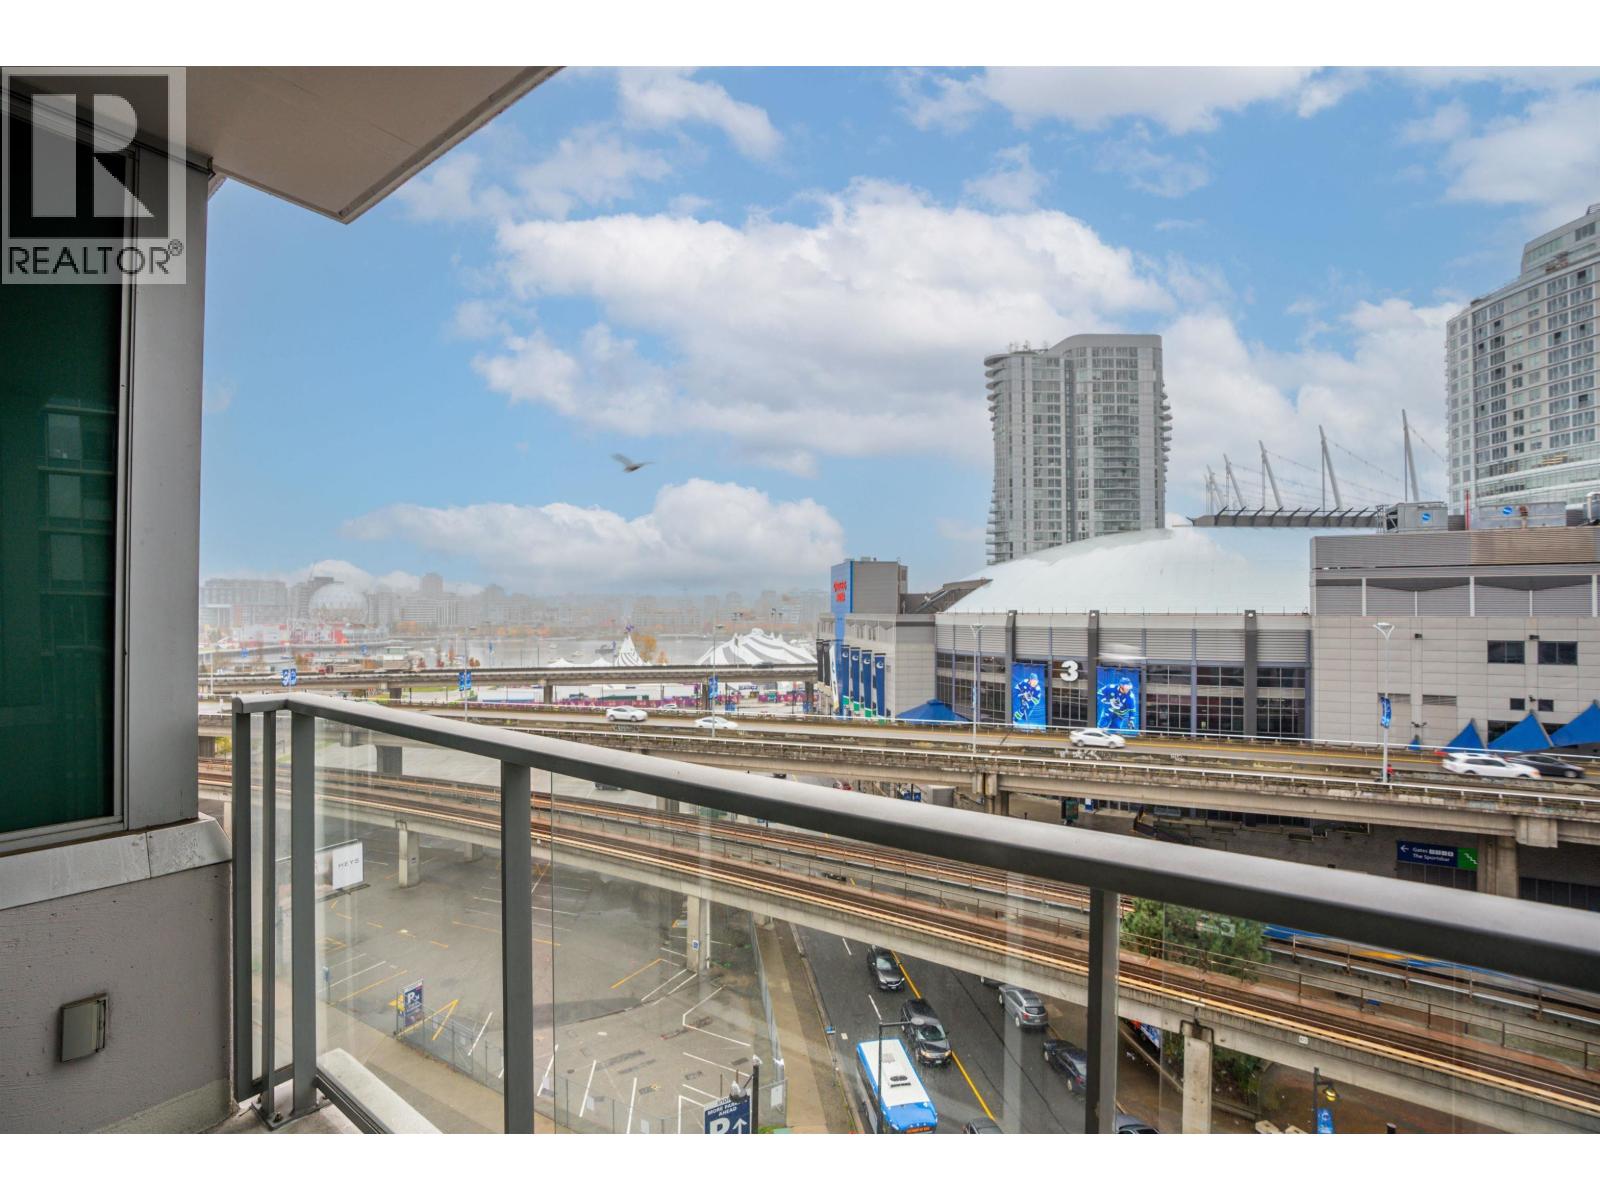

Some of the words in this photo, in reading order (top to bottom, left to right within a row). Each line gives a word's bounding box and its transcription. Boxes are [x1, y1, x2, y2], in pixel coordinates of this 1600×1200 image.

[1060, 660, 1079, 682] 3
[707, 1105, 723, 1115] MORE
[718, 1106, 737, 1116] AHEAD
[709, 1117, 731, 1134] P
